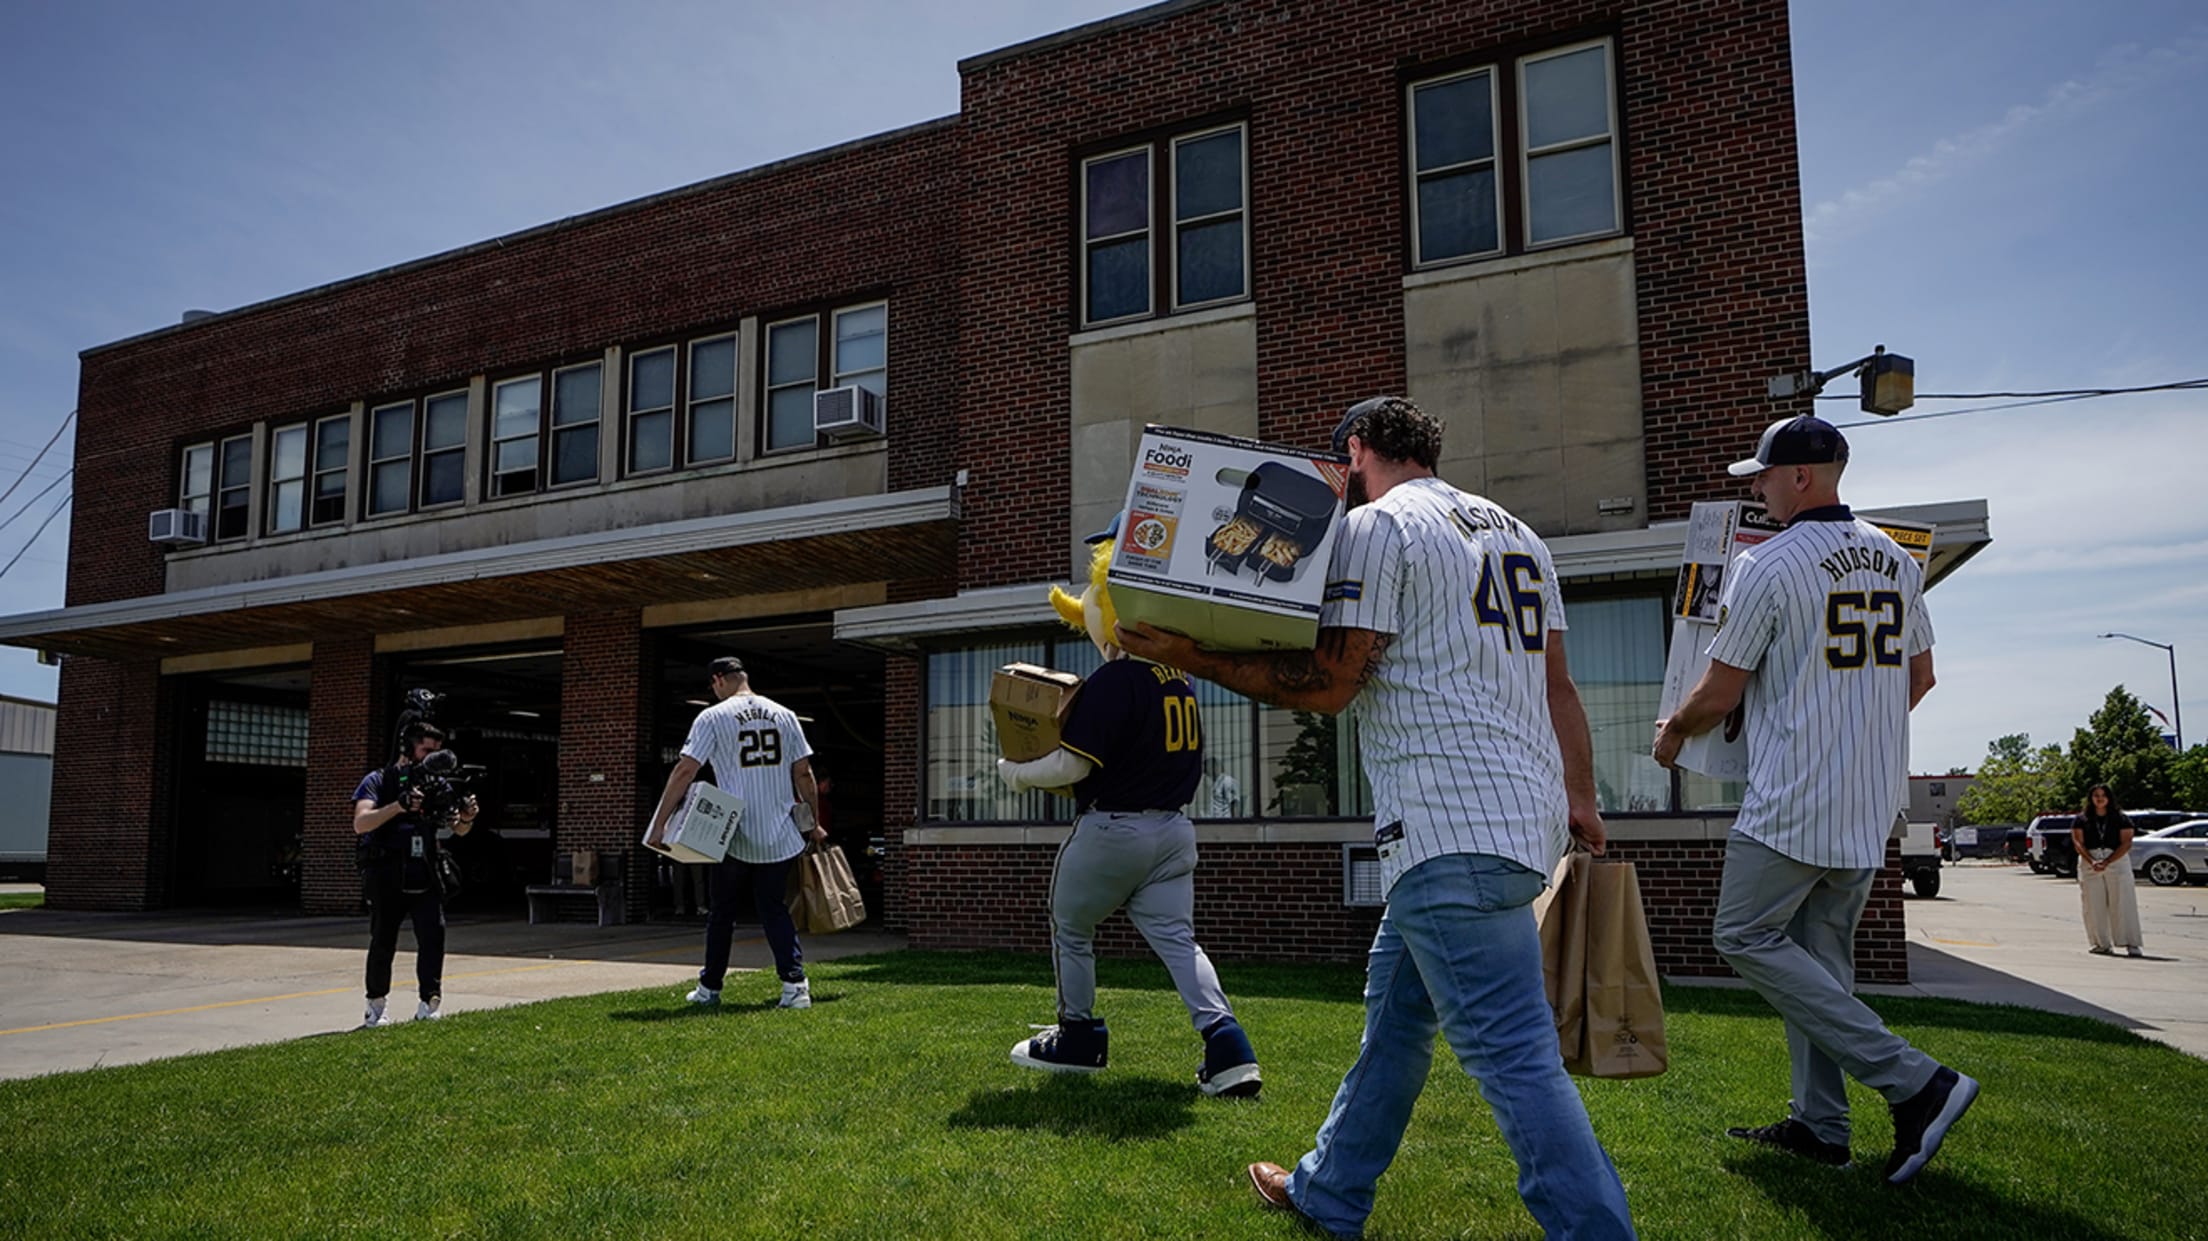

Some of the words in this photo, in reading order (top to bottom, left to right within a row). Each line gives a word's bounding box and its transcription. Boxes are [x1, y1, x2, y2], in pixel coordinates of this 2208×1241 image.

[1145, 449, 1193, 469] Foodi
[1819, 546, 1900, 582] HUDSON
[1471, 551, 1545, 655] 46
[1825, 590, 1904, 670] 52
[738, 728, 782, 768] 29
[1163, 696, 1199, 752] 00
